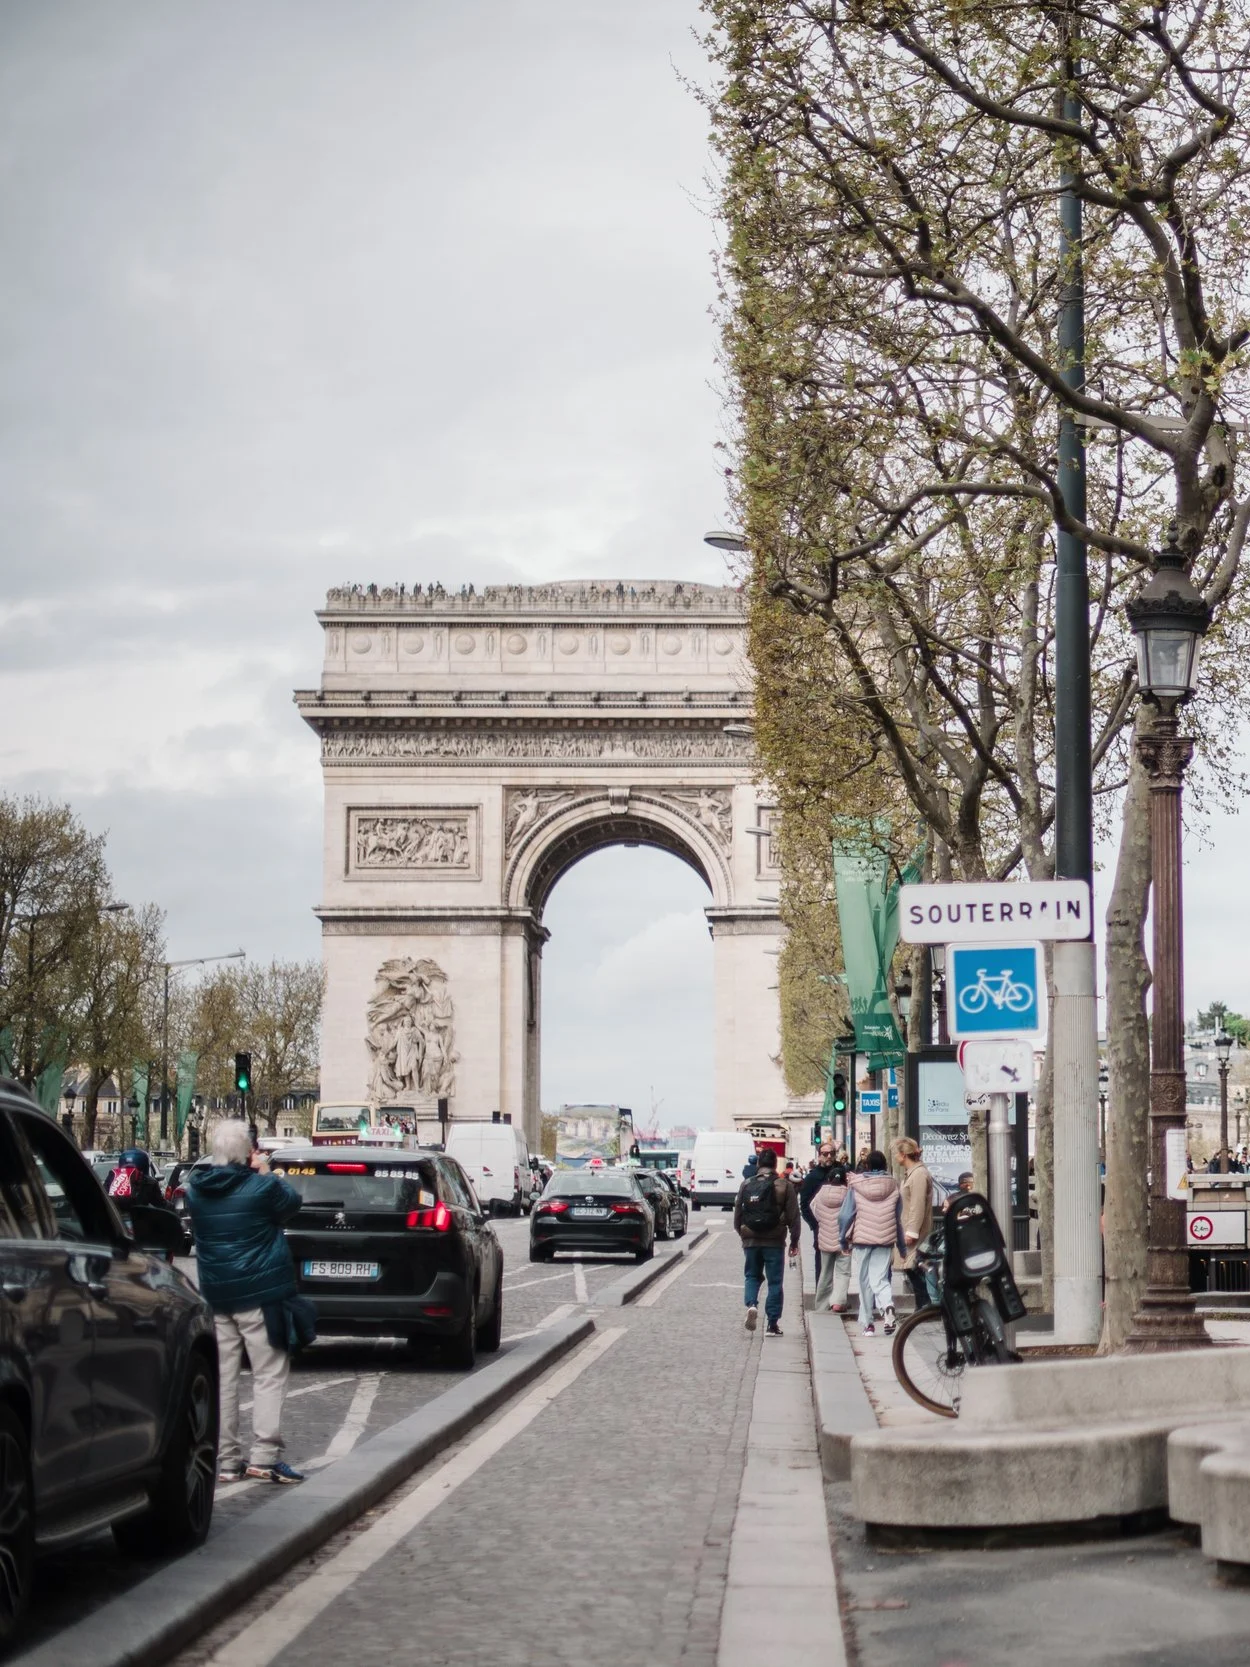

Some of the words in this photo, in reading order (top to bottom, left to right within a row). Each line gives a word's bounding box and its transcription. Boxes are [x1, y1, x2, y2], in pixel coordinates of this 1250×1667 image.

[862, 1099, 880, 1107] TAXIS
[370, 1127, 391, 1136] TAXI
[287, 1168, 300, 1176] 01
[374, 1170, 388, 1178] 85
[390, 1170, 404, 1178] 85
[405, 1171, 419, 1180] 85
